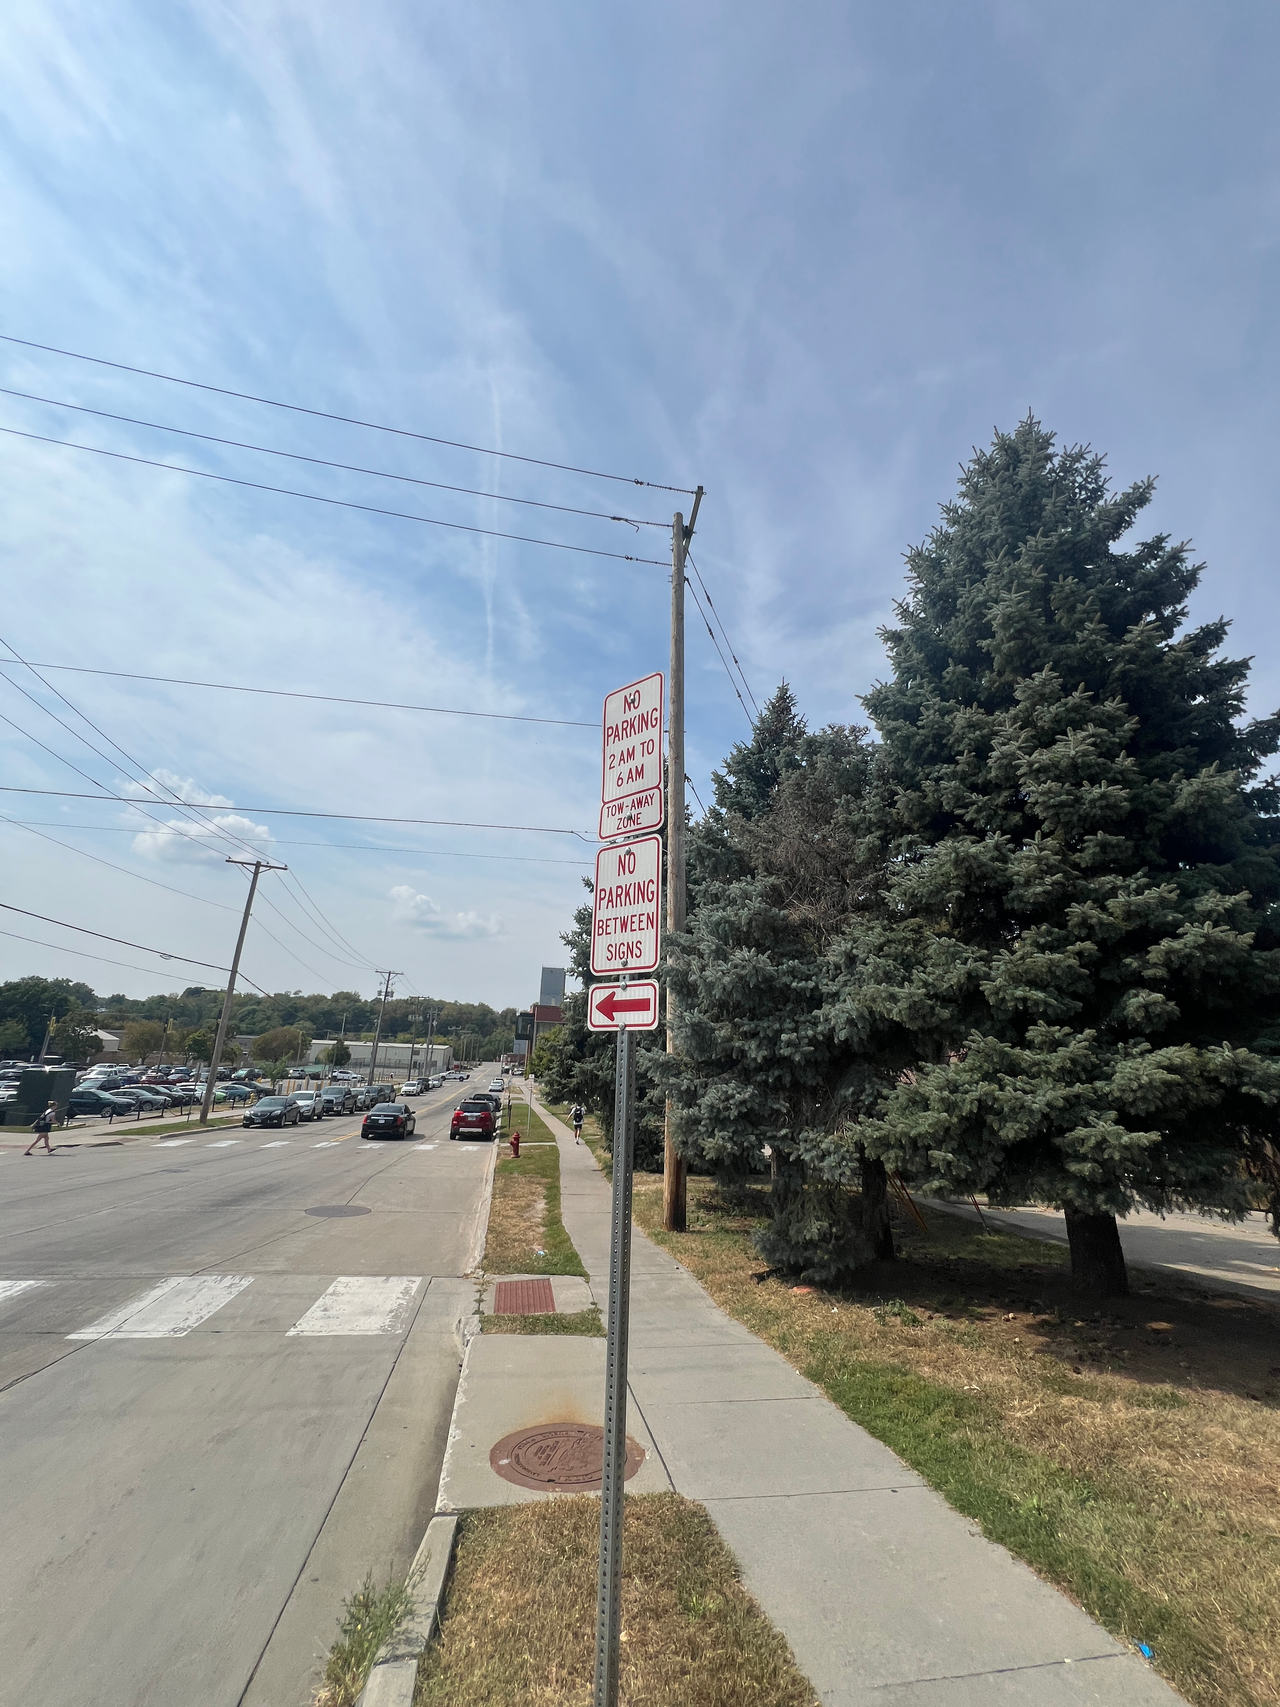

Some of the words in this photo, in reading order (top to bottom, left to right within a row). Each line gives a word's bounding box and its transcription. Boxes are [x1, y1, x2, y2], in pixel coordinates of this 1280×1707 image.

[623, 689, 641, 714] NO
[606, 707, 658, 747] PARKING
[608, 753, 616, 771] 2
[618, 745, 635, 766] AM
[640, 738, 655, 758] TO
[616, 771, 624, 787] 6
[626, 764, 644, 785] AM
[606, 792, 655, 818] TOW-AWAY
[616, 812, 642, 831] ZONE
[617, 852, 635, 876] NO
[598, 879, 655, 910] PARKING
[597, 912, 655, 937] BETWEEN
[606, 940, 642, 962] SIGNS
